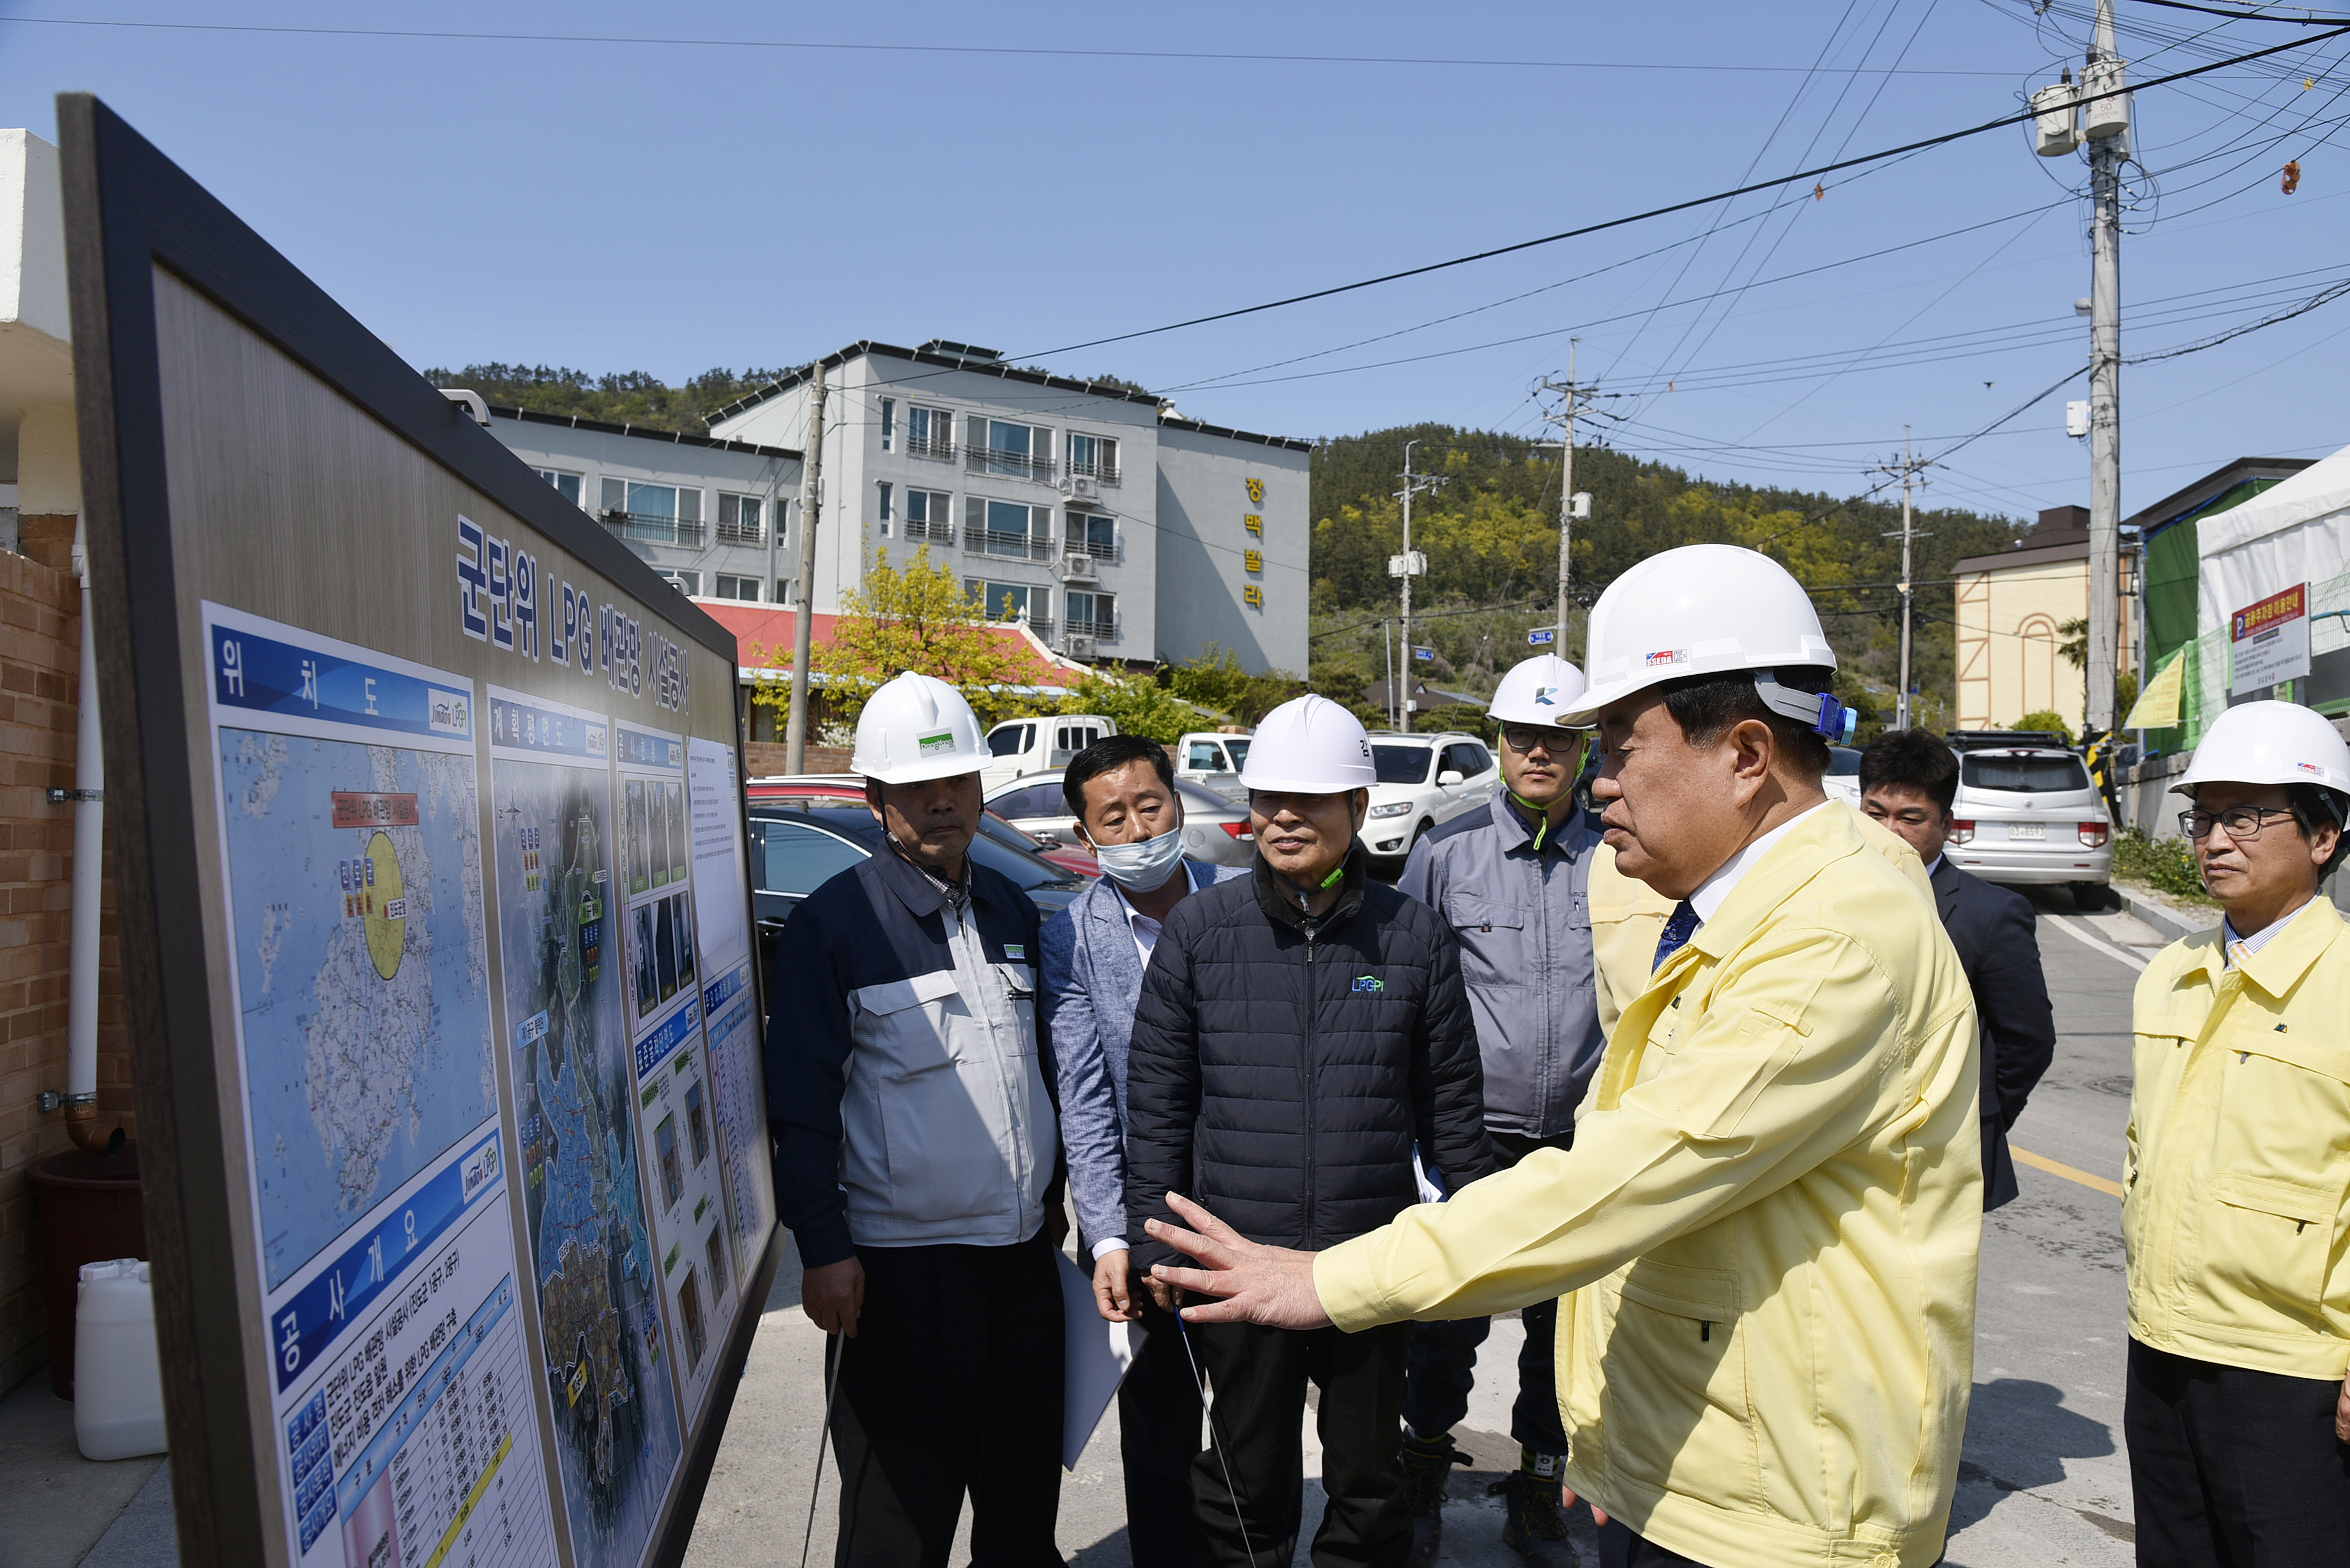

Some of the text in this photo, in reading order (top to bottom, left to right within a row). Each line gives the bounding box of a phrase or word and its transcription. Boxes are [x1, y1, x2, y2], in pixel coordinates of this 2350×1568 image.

[457, 514, 690, 716] 군단위 LPG 배관망 시설공사
[1647, 656, 1672, 666] SSEDA
[357, 799, 372, 820] LPG
[1352, 977, 1384, 992] LPGPI
[349, 1348, 364, 1383] LPG
[417, 1338, 429, 1371] LPG
[330, 1393, 352, 1442] 진도군
